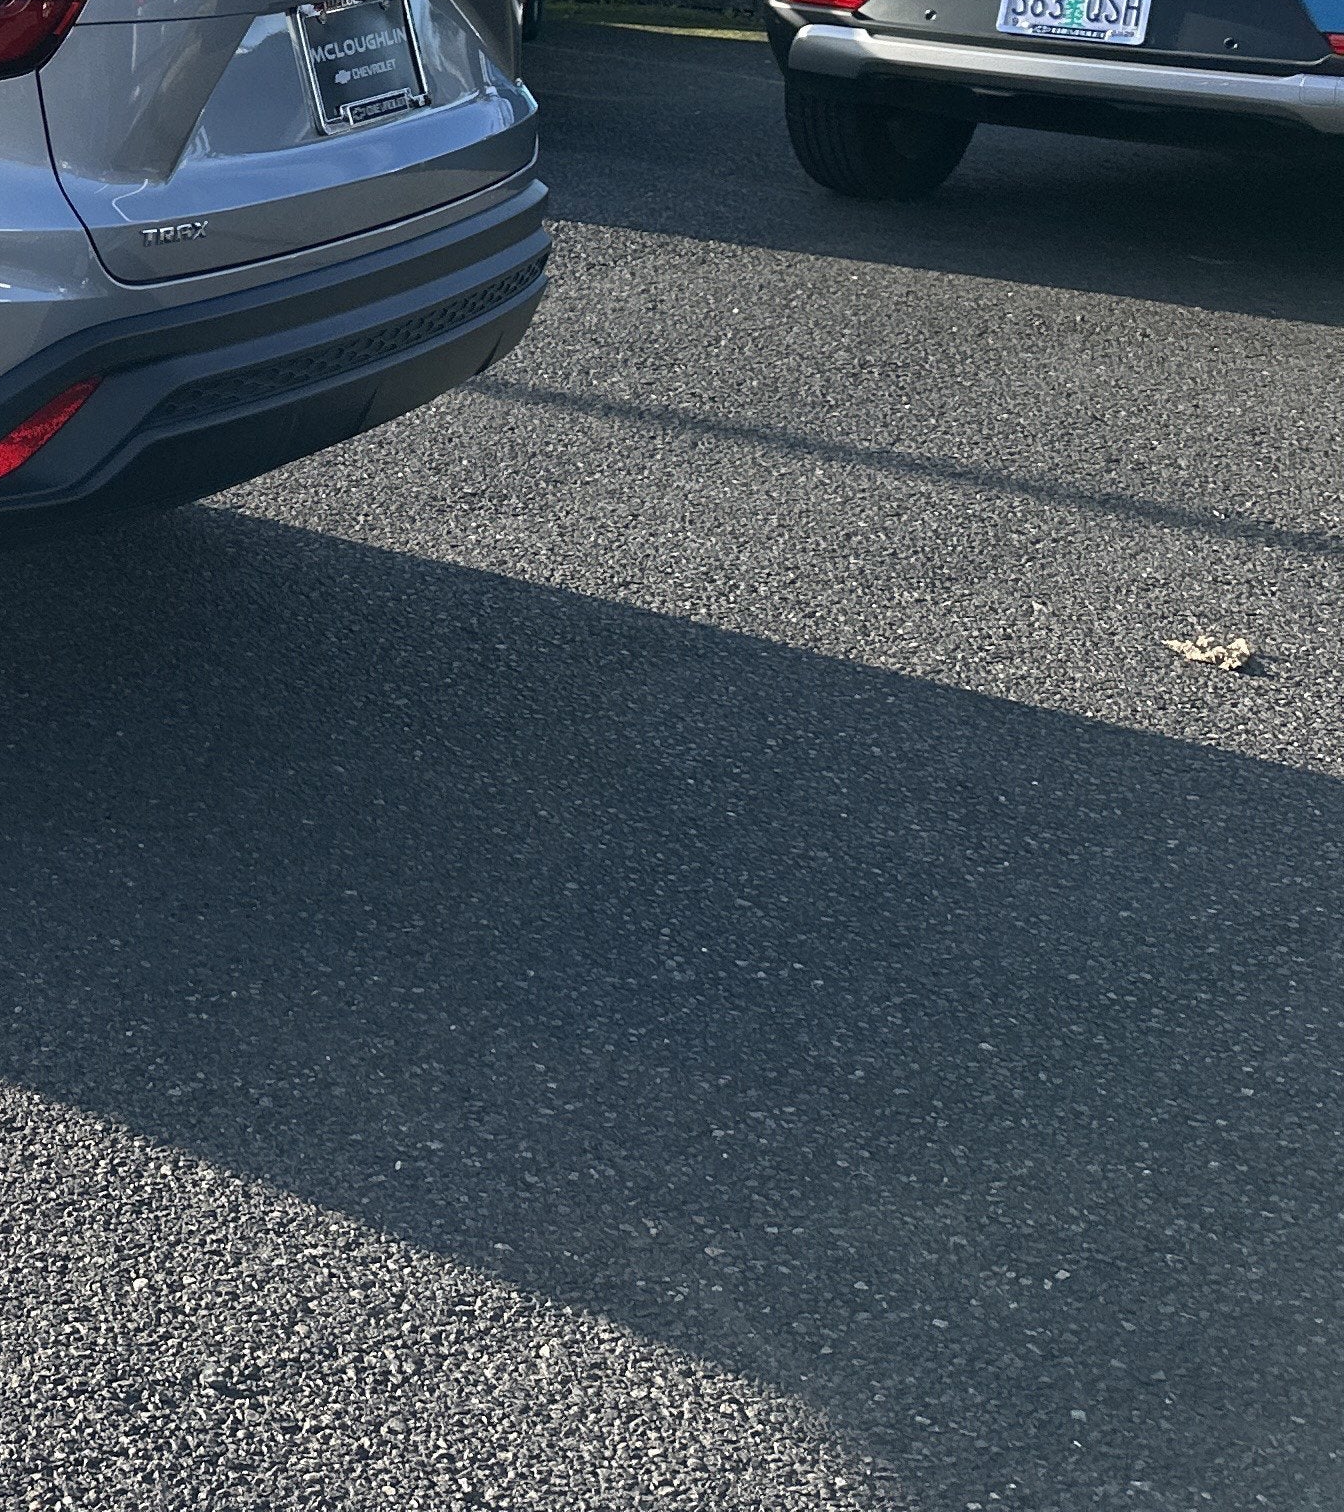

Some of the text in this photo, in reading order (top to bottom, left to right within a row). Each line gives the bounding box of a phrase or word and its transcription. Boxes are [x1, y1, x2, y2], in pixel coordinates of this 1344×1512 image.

[311, 26, 408, 65] MCLOUGHLIN
[352, 58, 396, 80] CHEVROLET
[140, 220, 209, 247] TRAX
